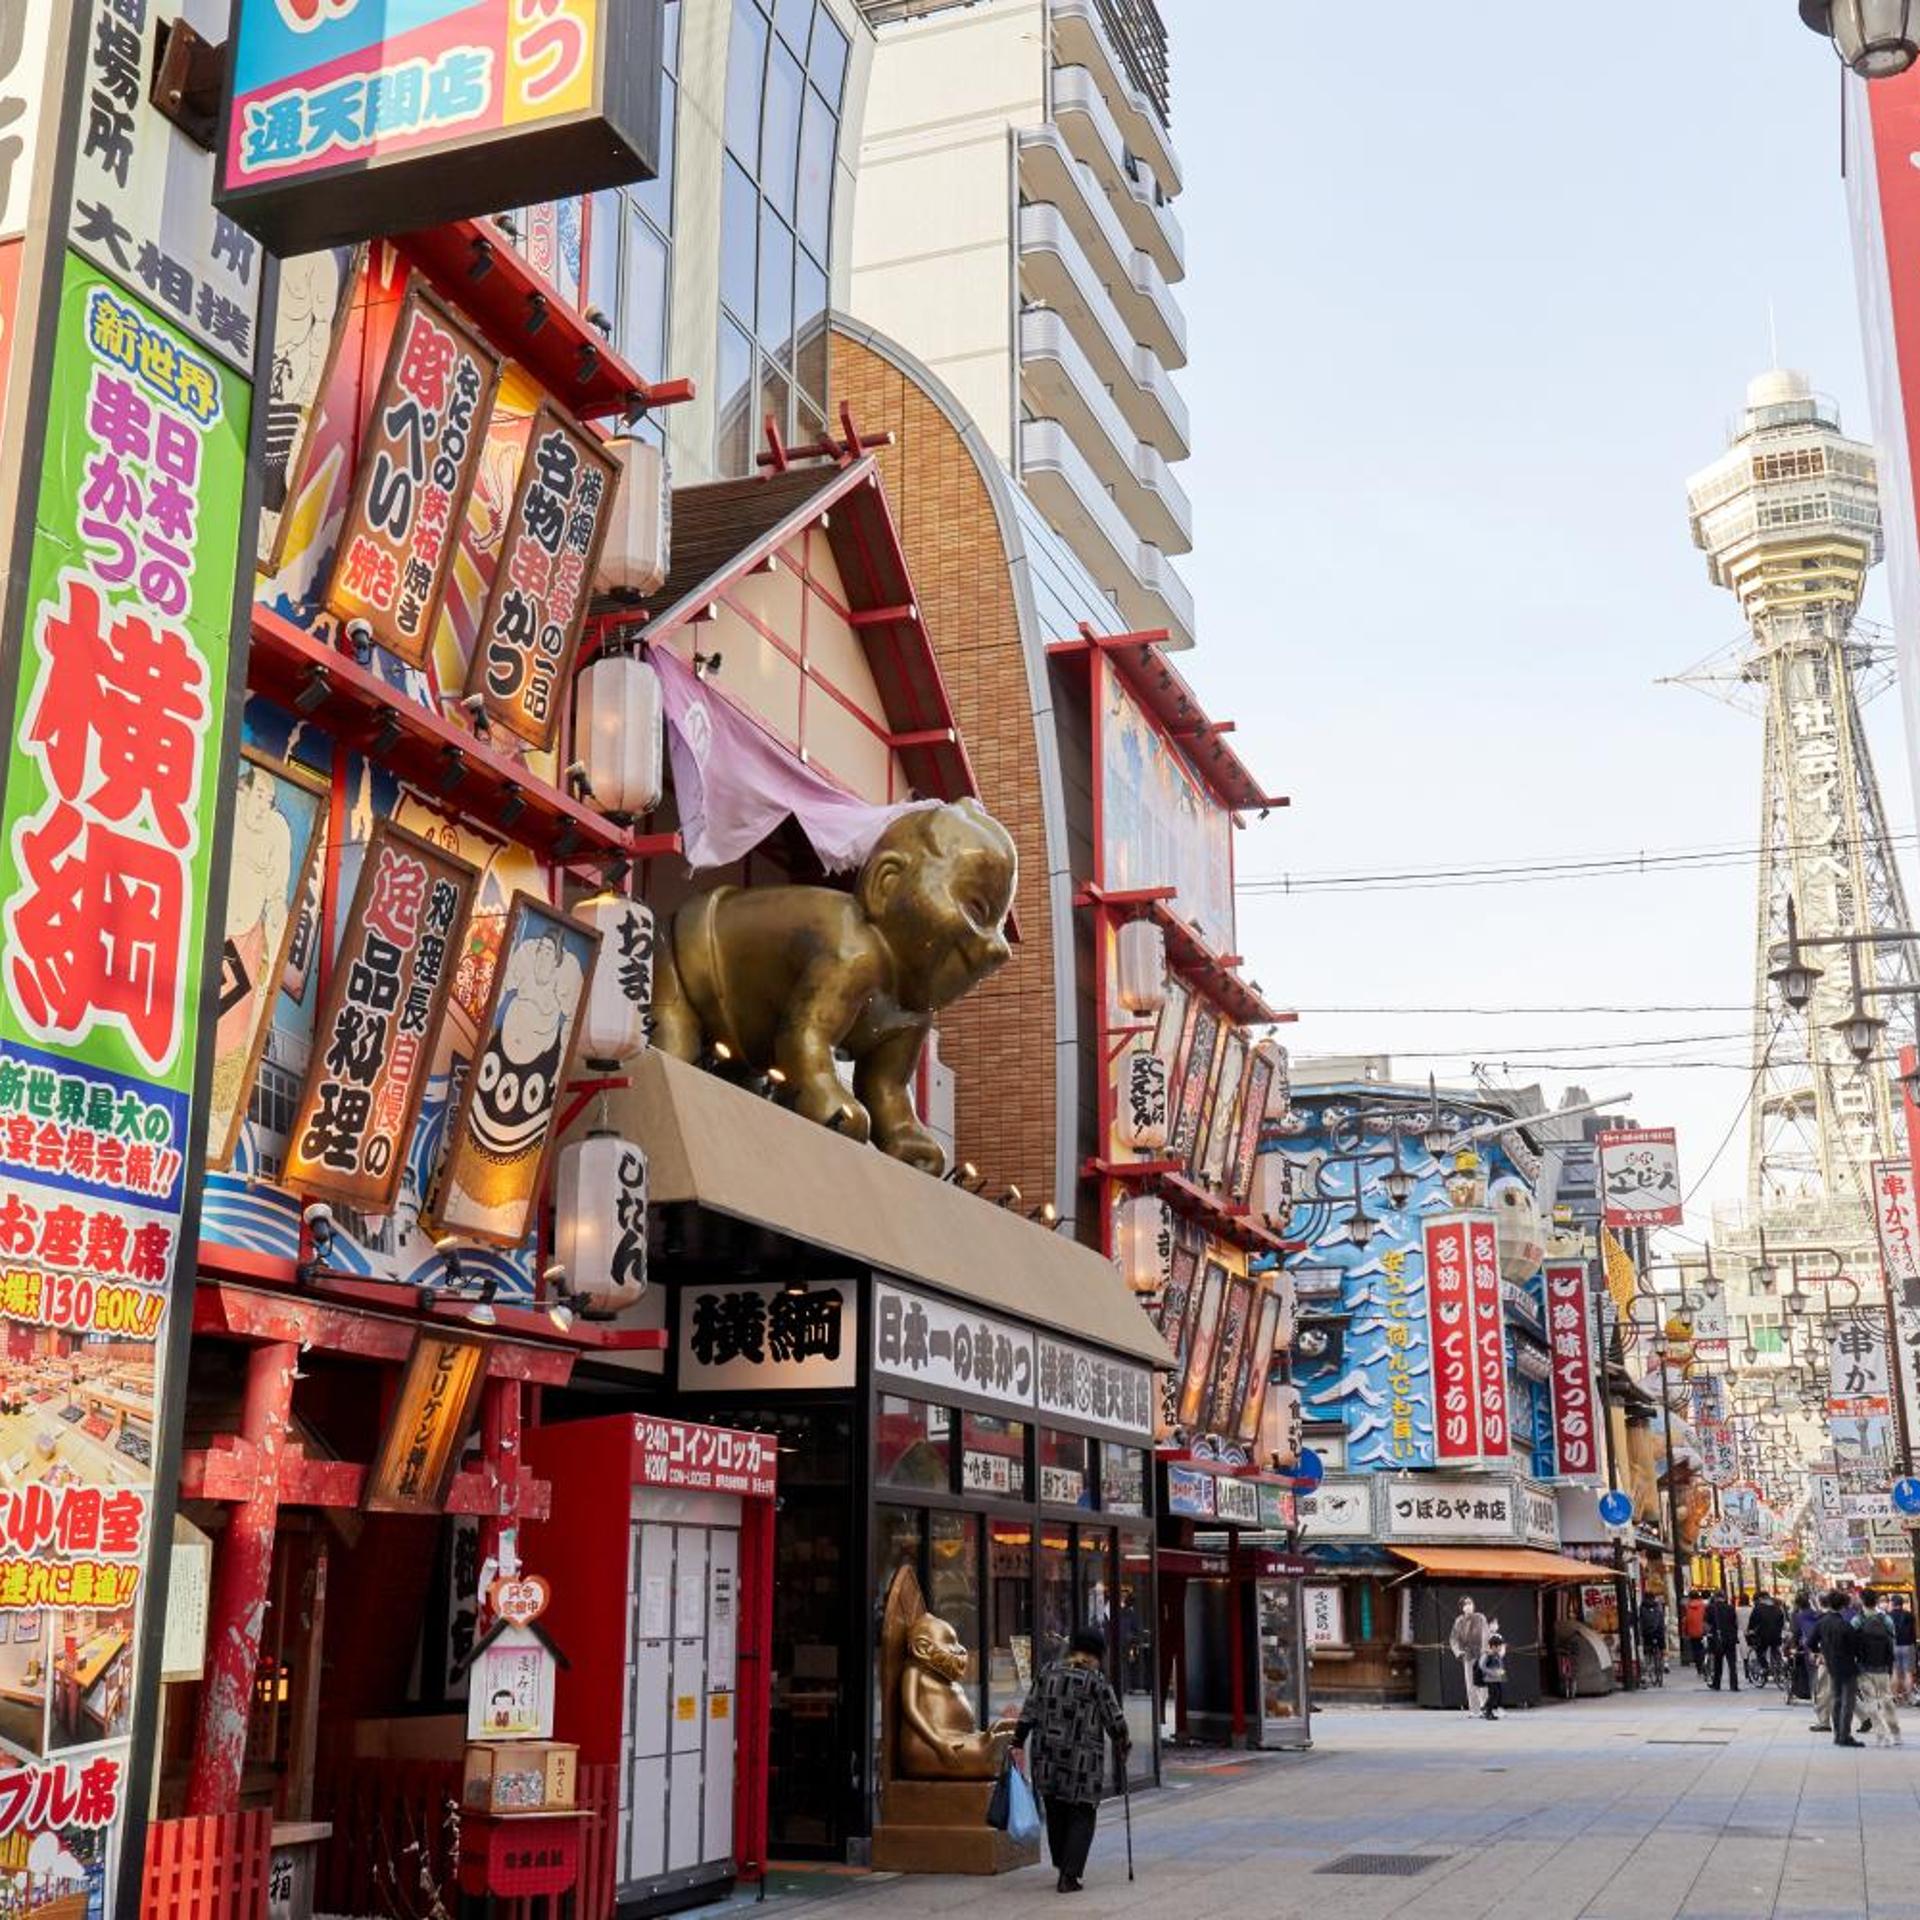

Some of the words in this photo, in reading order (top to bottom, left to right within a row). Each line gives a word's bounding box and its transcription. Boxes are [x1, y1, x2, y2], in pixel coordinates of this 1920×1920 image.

[249, 53, 488, 167] 通天閣店
[74, 200, 251, 358] 大相撲
[92, 294, 218, 424] 新世界
[83, 374, 151, 583] 串かつ
[138, 411, 198, 617] 日本一の
[344, 315, 453, 607] 豚ぺい焼き
[400, 360, 478, 632] なにわの鉄板焼き
[488, 432, 576, 698] 名物串かつ
[28, 581, 203, 1063] 横綱
[304, 852, 424, 1168] 逸品料理
[0, 1062, 172, 1144] 新世界最大の
[0, 1114, 178, 1193] 宴会場完備!!
[0, 1196, 171, 1281] お座敷席
[1882, 1174, 1910, 1242] 串かつ
[690, 1288, 842, 1366] 横綱
[878, 1295, 1034, 1397] 日本一の串かつ
[1553, 1303, 1588, 1467] 珍味てっちり
[670, 1426, 776, 1473] コインロッカー
[1396, 1498, 1507, 1521] づぼらや本店
